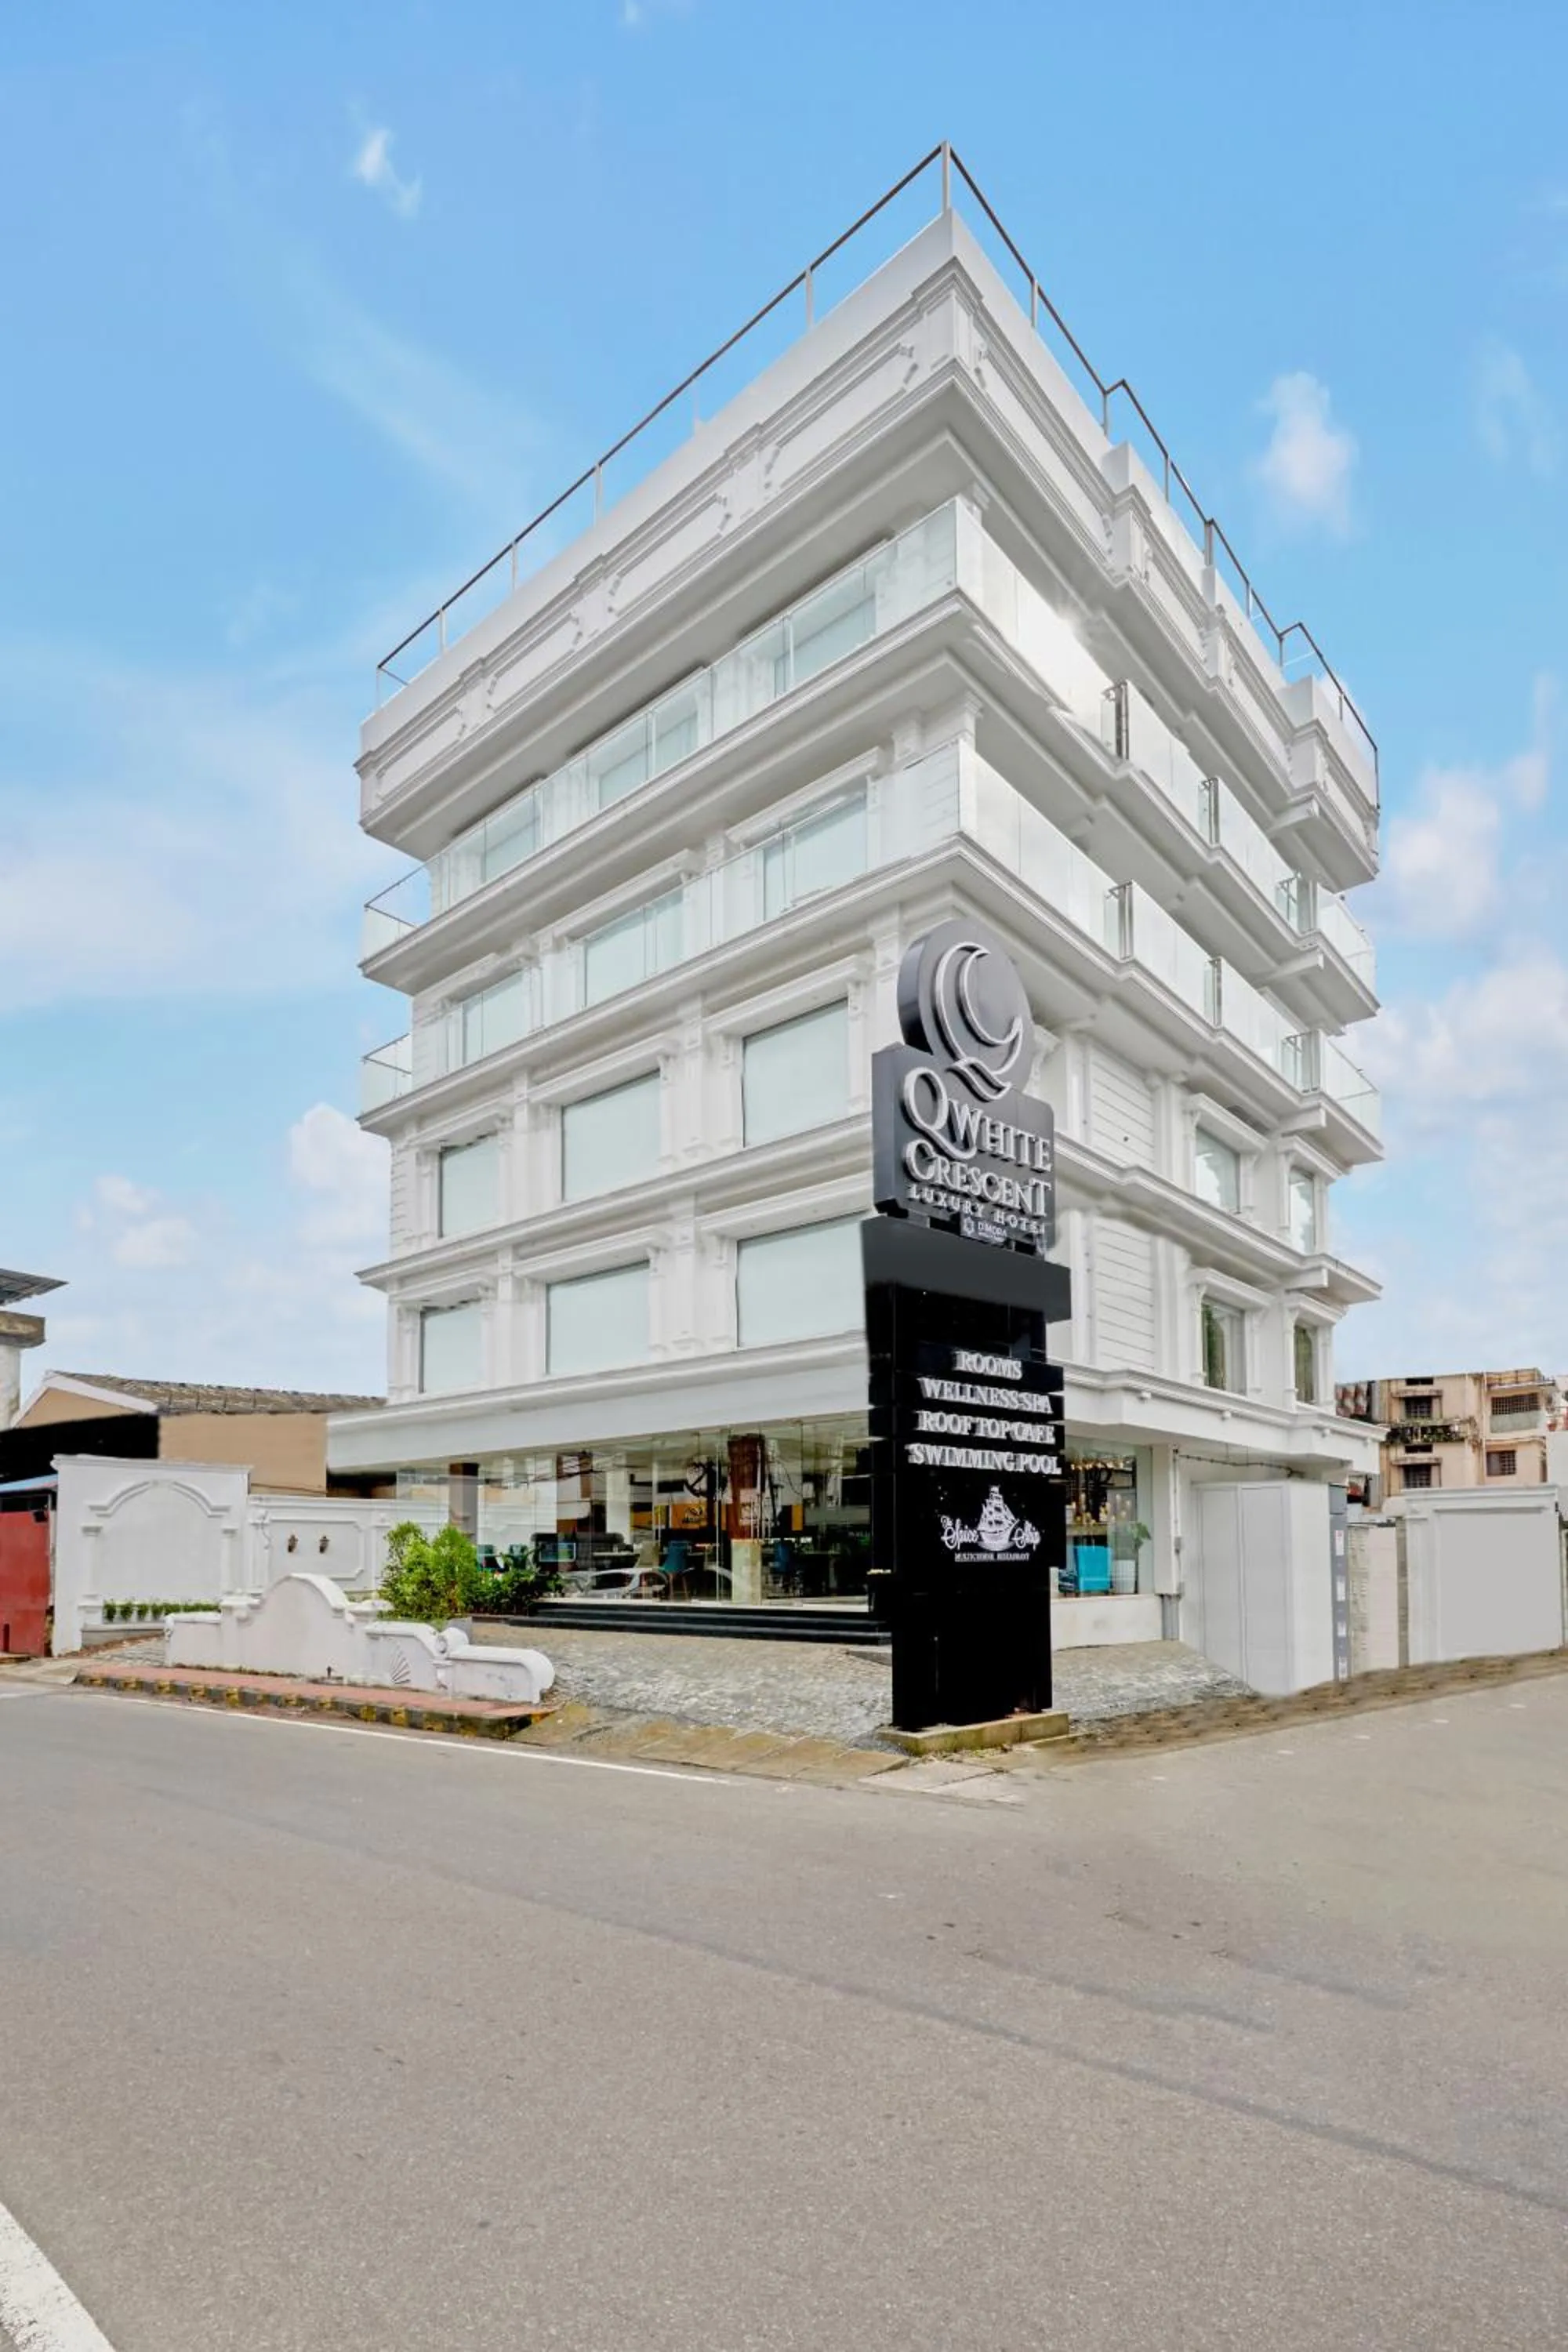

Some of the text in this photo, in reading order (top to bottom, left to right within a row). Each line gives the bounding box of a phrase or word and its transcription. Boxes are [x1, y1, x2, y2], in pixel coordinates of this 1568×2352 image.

[905, 1138, 1053, 1218] CRESCENT
[907, 1183, 1046, 1236] LUXURY HOTEL
[953, 1351, 1023, 1380] ROOMS
[914, 1410, 1056, 1445] ROOF TOP CAFE
[904, 1443, 1062, 1475] SWIMMING POOL
